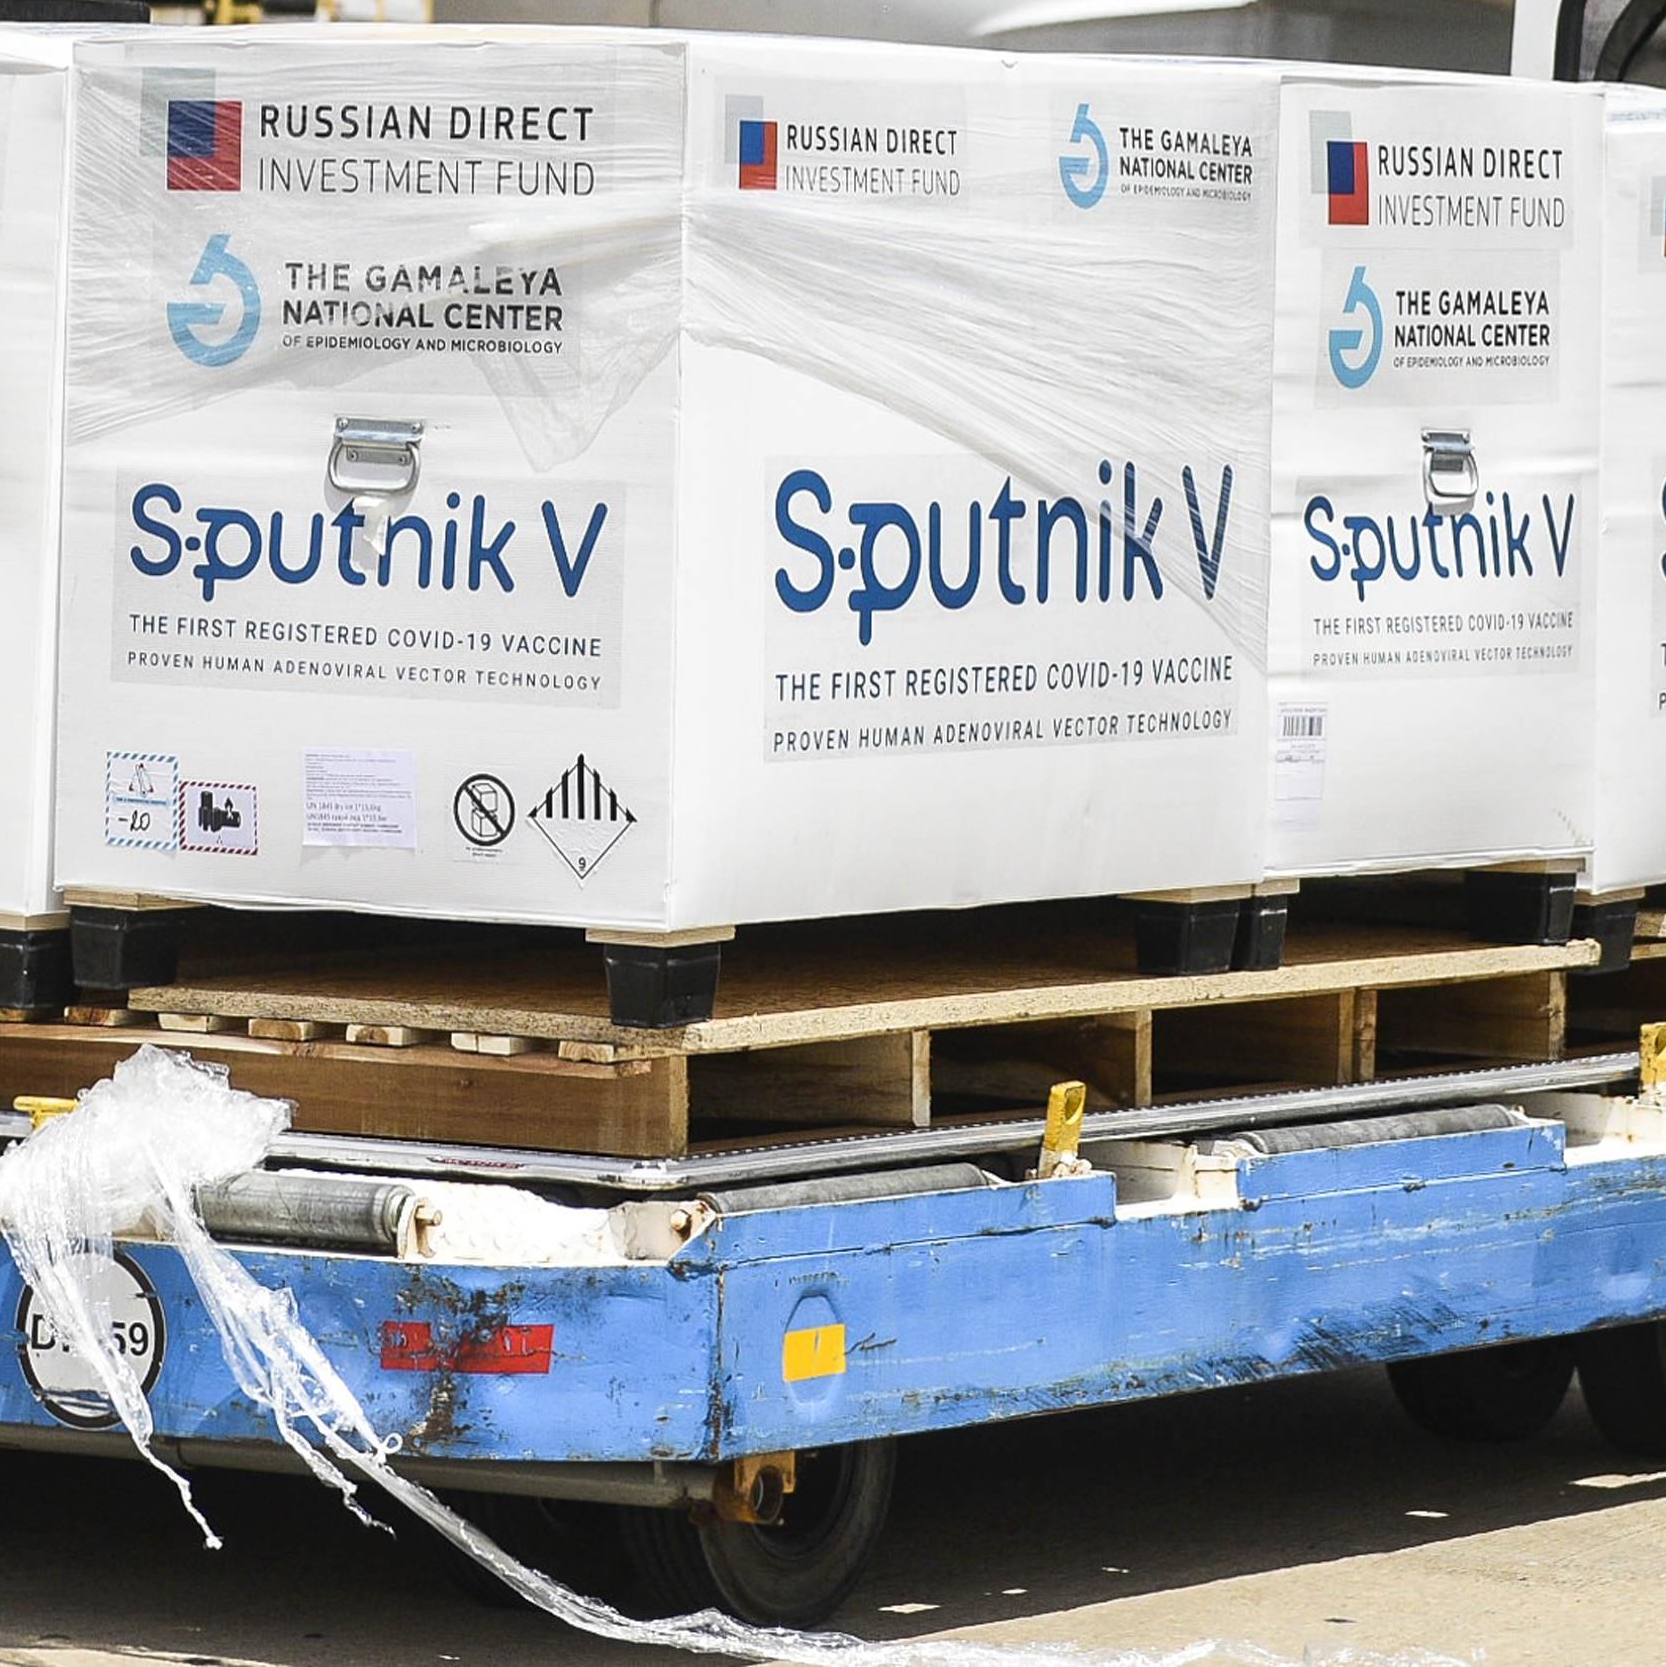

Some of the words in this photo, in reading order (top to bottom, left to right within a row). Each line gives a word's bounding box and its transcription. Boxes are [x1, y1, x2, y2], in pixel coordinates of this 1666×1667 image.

[260, 105, 431, 139] RUSSIAN
[449, 107, 593, 140] DIRECT
[787, 124, 877, 152] RUSSIAN
[886, 129, 957, 155] DIRECT
[1119, 127, 1153, 150] THE
[1160, 130, 1252, 157] GAMALEYA
[259, 157, 482, 194] INVESTMENT
[496, 158, 595, 195] FUND
[1119, 156, 1195, 180] NATIONAL
[1198, 160, 1252, 184] CENTER
[1377, 145, 1472, 177] RUSSIAN
[1483, 148, 1562, 179] DIRECT
[784, 165, 905, 198] INVESTMENT
[909, 166, 960, 199] FUND
[1378, 195, 1503, 226] INVESTMENT
[1510, 197, 1564, 228] FUND
[284, 263, 350, 293] THE
[364, 265, 562, 296] GAMALEYA
[283, 300, 434, 328] NATIONAL
[443, 303, 562, 331] CENTER
[1395, 291, 1431, 315] THE
[1438, 290, 1549, 315] GAMALEYA
[282, 335, 301, 347] OF
[305, 334, 411, 350] EPIDEMIOLOGY
[414, 336, 445, 351] AND
[450, 338, 562, 354] MICROBIOLOGY
[1394, 324, 1476, 347] NATIONAL
[1481, 324, 1550, 347] CENTER
[1393, 356, 1405, 368] OF
[1407, 356, 1463, 368] EPIDEMIOLOGY
[1466, 355, 1483, 367] AND
[1485, 354, 1550, 367] MICROBIOLOGY
[130, 483, 516, 602] Sputnik
[542, 501, 608, 597] V
[775, 460, 1163, 646] Sputnik
[1183, 464, 1232, 600] V
[1305, 493, 1533, 601] Sputnik
[1543, 494, 1576, 578] V
[129, 614, 168, 634] THE
[177, 617, 236, 638] FIRST
[244, 621, 377, 645] REGISTERED
[387, 629, 491, 651] COVID-19
[501, 634, 601, 657] VACCINE
[1313, 618, 1340, 635] THE
[1345, 617, 1381, 634] FIRST
[1385, 615, 1463, 634] REGISTERED
[1468, 613, 1523, 632] COVID-19
[1527, 612, 1573, 629] VACCINE
[127, 651, 193, 668] PROVEN
[202, 653, 263, 672] HUMAN
[273, 660, 386, 679] ADENOVIRAL
[395, 664, 466, 683] VECTOR
[475, 670, 600, 690] TECHNOLOGY
[1311, 652, 1358, 666] PROVEN
[1363, 652, 1400, 664] HUMAN
[1404, 649, 1470, 663] ADENOVIRAL
[1473, 647, 1512, 661] VECTOR
[1515, 645, 1573, 659] TECHNOLOGY
[775, 673, 821, 701] THE
[831, 670, 896, 699] FIRST
[905, 665, 1037, 696] REGISTERED
[1046, 660, 1142, 690] COVID-19
[1152, 656, 1232, 684] VACCINE
[773, 729, 848, 752] PROVEN
[858, 726, 924, 750] HUMAN
[932, 720, 1043, 744] ADENOVIRAL
[1053, 715, 1118, 738] VECTOR
[1126, 709, 1231, 733] TECHNOLOGY
[578, 857, 587, 869] 9
